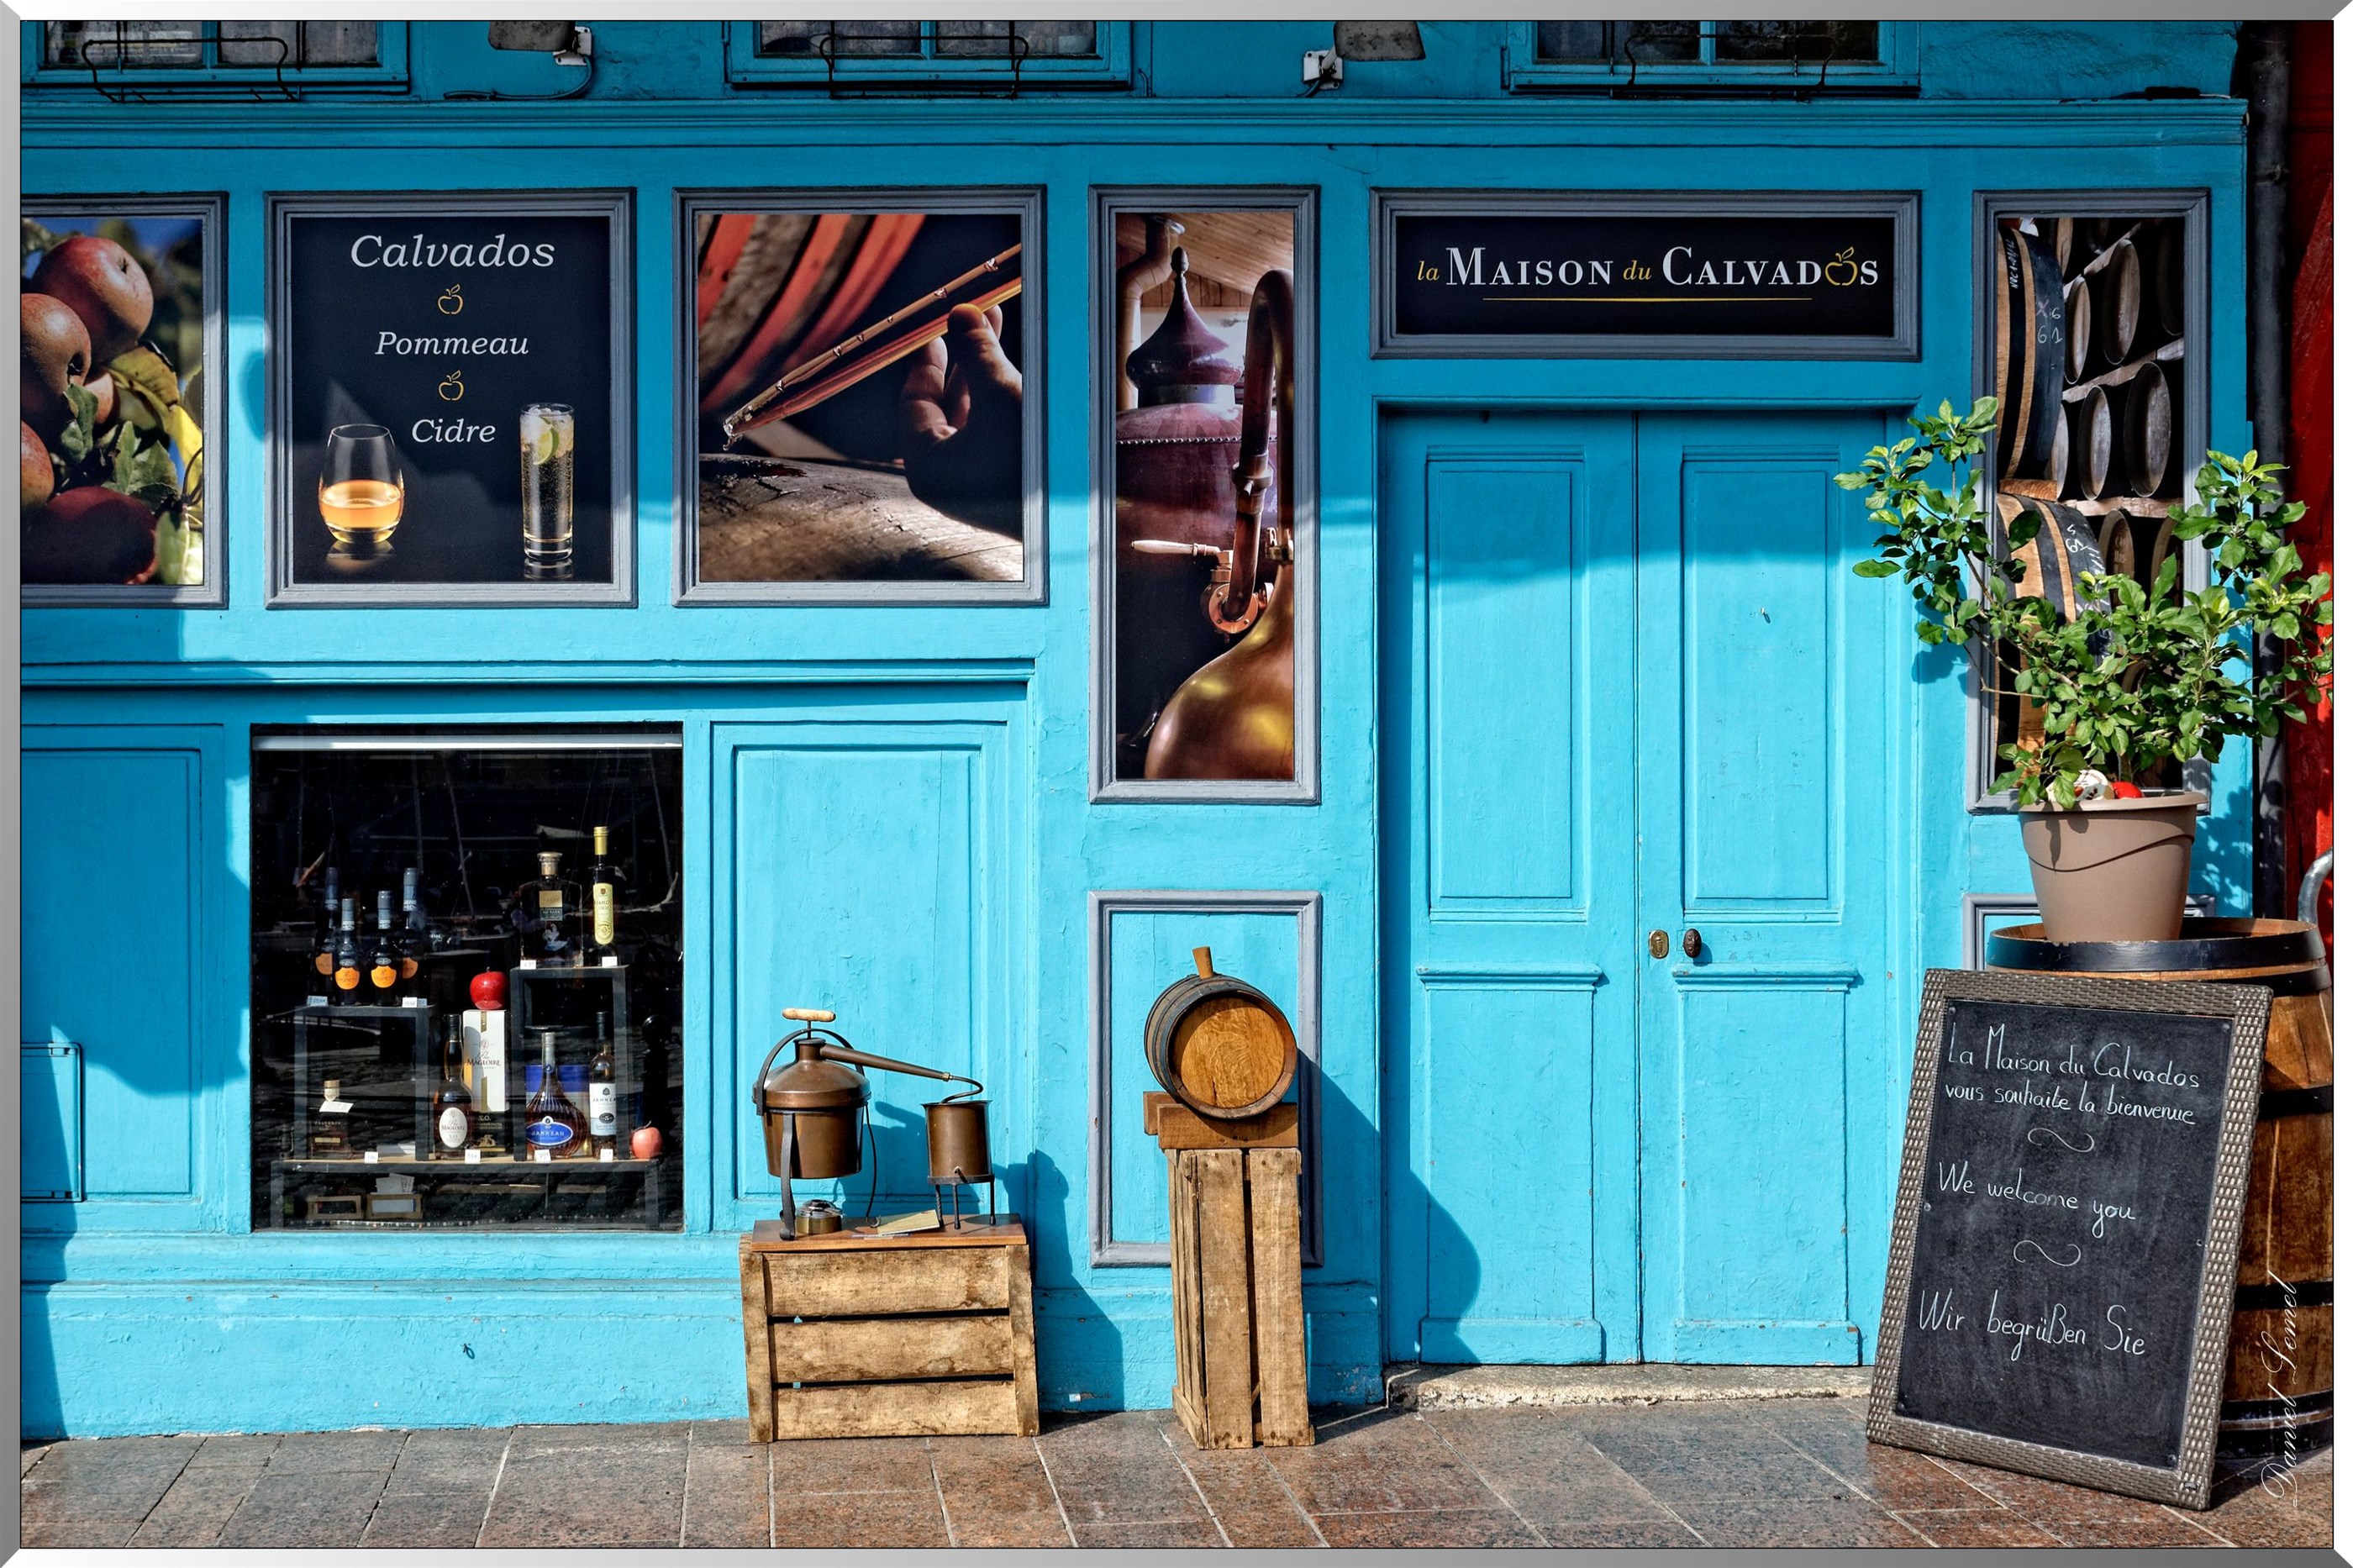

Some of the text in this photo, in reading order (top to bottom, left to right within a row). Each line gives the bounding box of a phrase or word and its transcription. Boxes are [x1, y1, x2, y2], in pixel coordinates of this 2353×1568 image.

[351, 234, 555, 267] Calvados
[1417, 246, 1879, 286] la MAISON du CALVADOS
[375, 331, 529, 355] Pommeau
[412, 418, 496, 443] Cidre
[1948, 1022, 2201, 1088] La Maison du Calvados
[1945, 1079, 2196, 1125] vous souhaite la bienvenue
[1939, 1160, 2136, 1239] We welcome you
[1919, 1288, 2145, 1361] Wir begrüßen Sie
